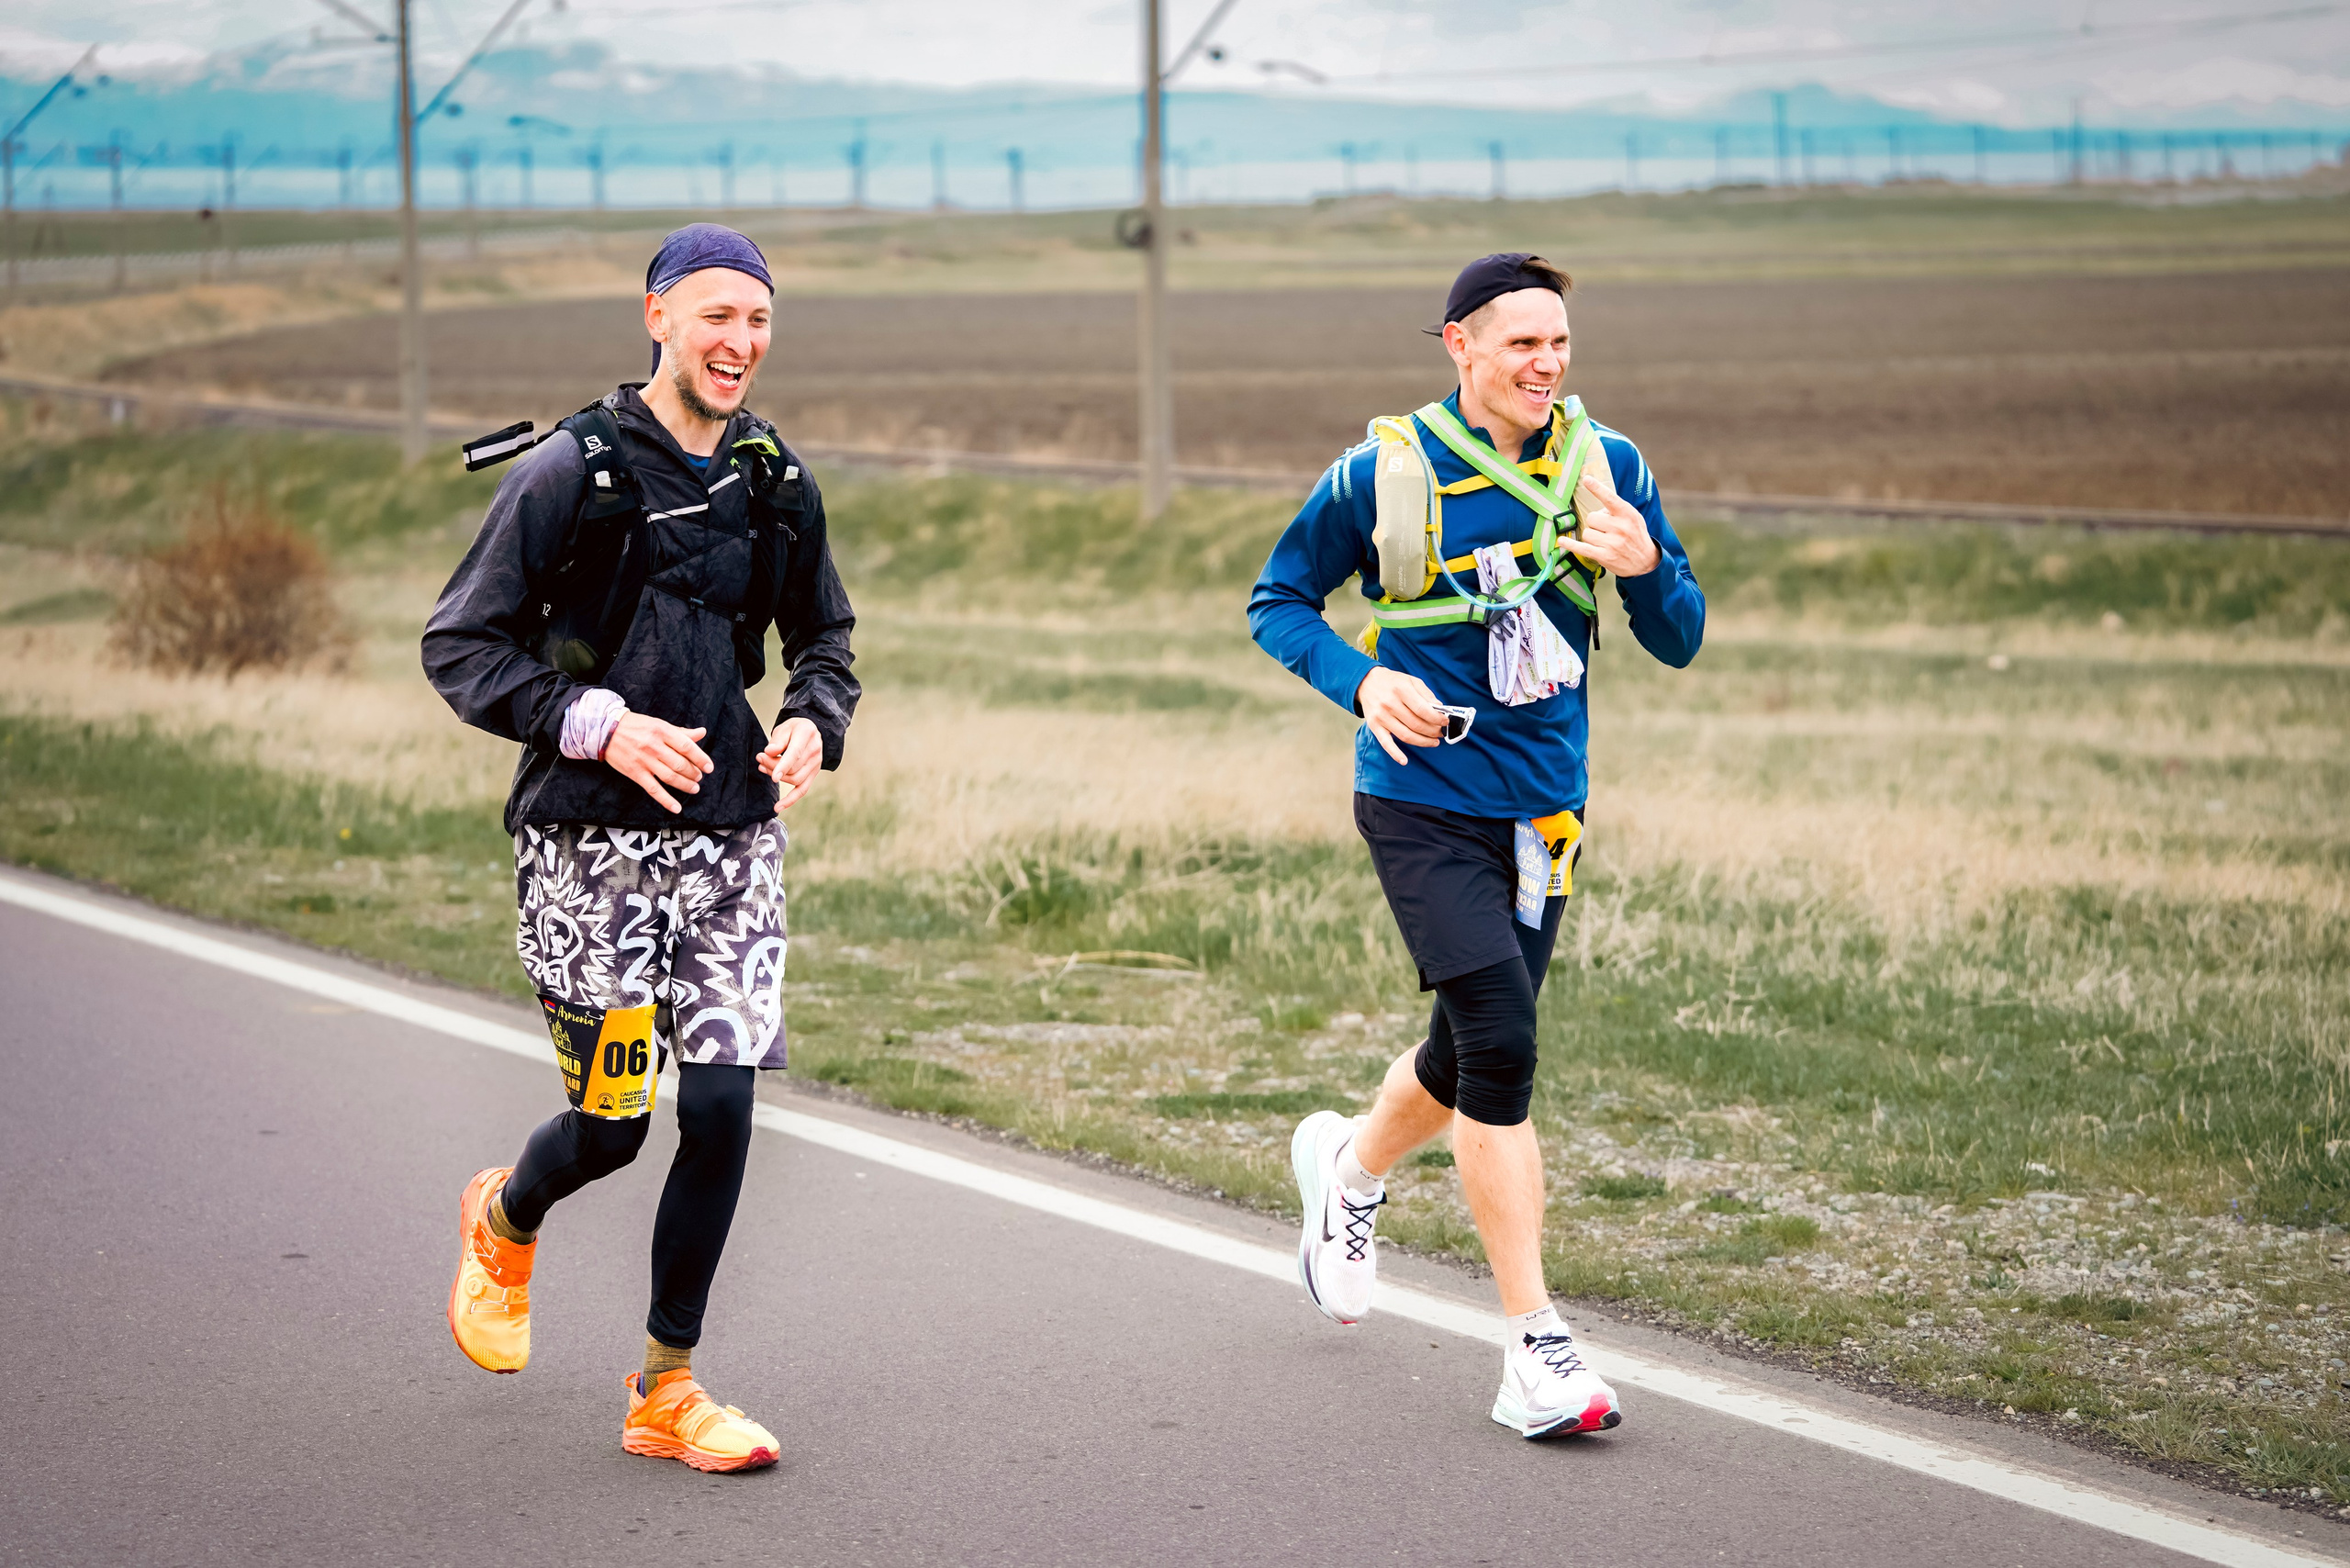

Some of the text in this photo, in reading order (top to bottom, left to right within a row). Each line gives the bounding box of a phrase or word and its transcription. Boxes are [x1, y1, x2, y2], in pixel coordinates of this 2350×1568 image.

[543, 603, 551, 616] 12
[1544, 838, 1568, 860] 4
[557, 1005, 596, 1026] Armenia
[556, 1049, 581, 1076] ORLD
[603, 1038, 648, 1079] 06
[620, 1089, 646, 1097] CAUCASUS
[620, 1095, 647, 1103] UNITED
[620, 1102, 646, 1110] TERRITORY
